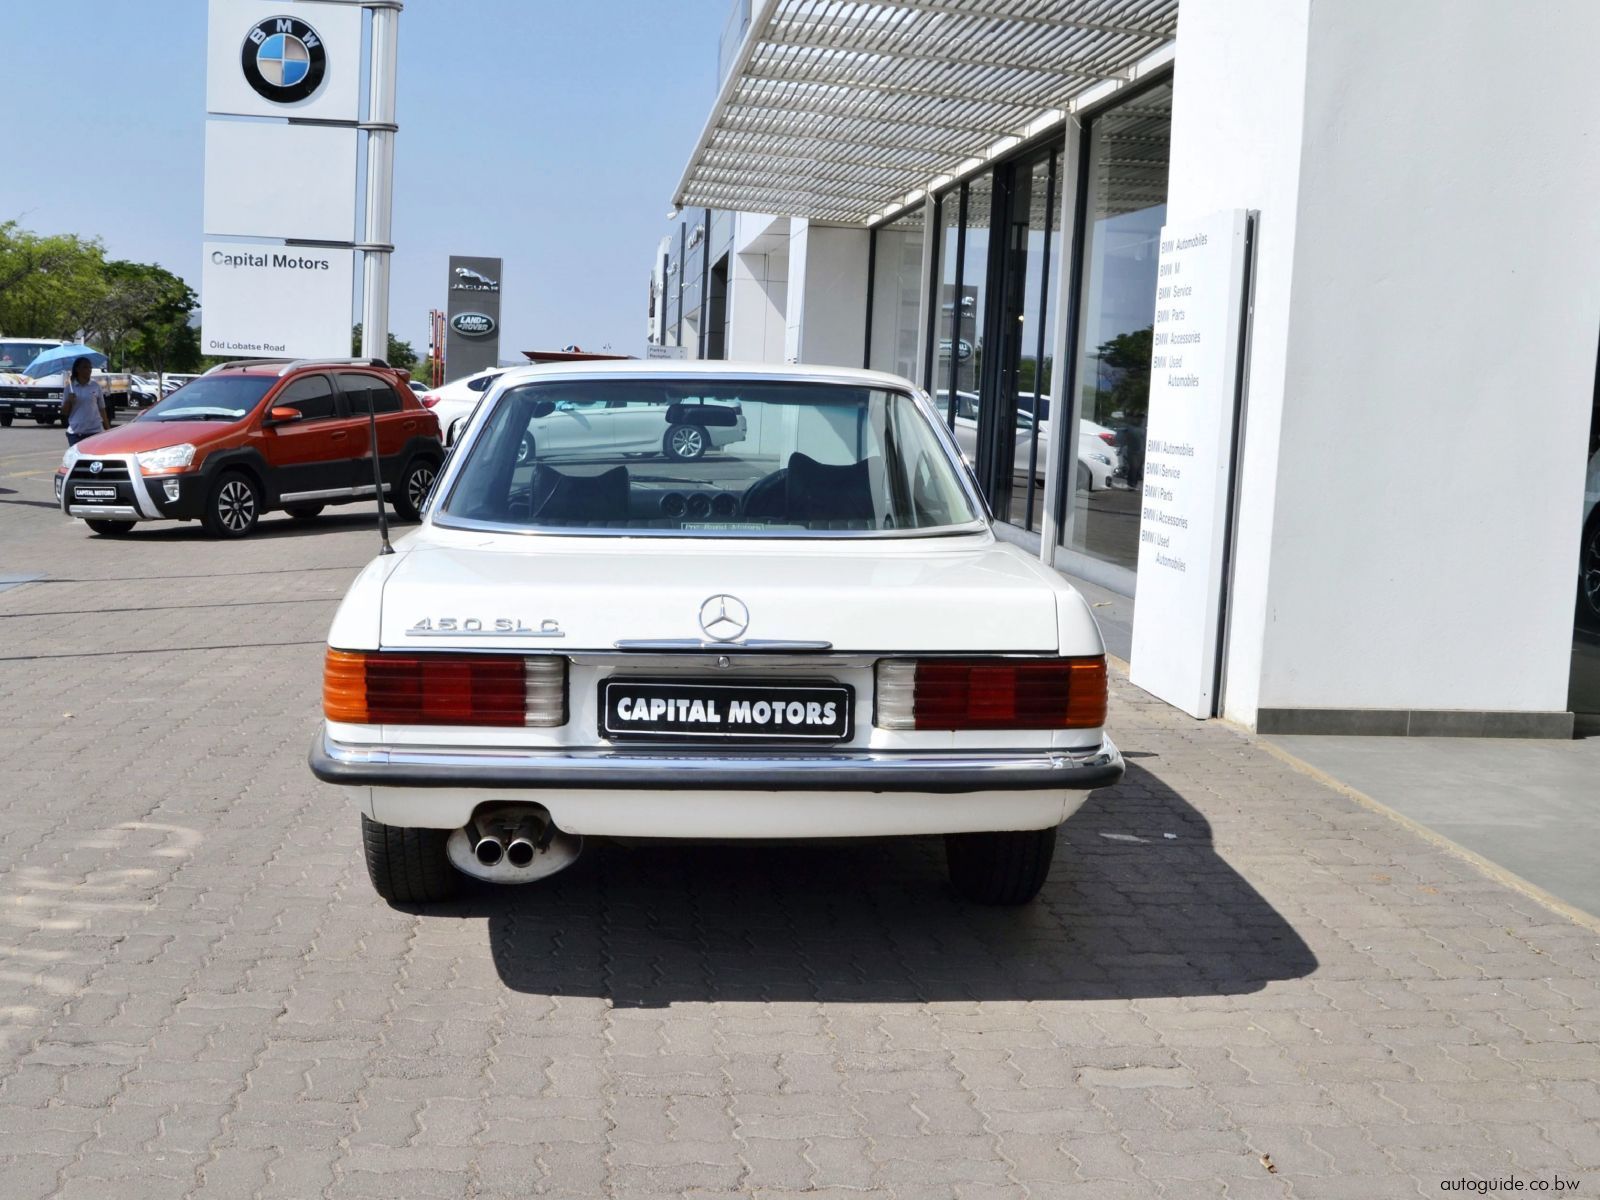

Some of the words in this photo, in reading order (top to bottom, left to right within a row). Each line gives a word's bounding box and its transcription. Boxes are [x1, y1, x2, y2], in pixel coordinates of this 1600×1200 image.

[249, 19, 319, 48] BMW
[1161, 240, 1174, 254] BMW
[1176, 232, 1208, 251] Automobiles
[211, 251, 268, 269] Capital
[273, 254, 329, 270] Motors
[1160, 263, 1172, 277] BMW
[450, 283, 499, 291] JAGUAR
[1158, 286, 1171, 300] BMW
[1173, 284, 1193, 298] Service
[460, 316, 481, 324] LAND
[1157, 309, 1170, 323] BMW
[1171, 308, 1185, 321] Parts
[461, 323, 488, 331] ROVER
[209, 340, 225, 349] Old
[226, 341, 262, 351] Lobatse
[263, 343, 286, 352] Road
[1155, 333, 1168, 346] BMW
[1170, 331, 1201, 345] Accessories
[1153, 355, 1167, 369] BMW
[1168, 355, 1183, 369] Used
[1167, 373, 1200, 387] Automobiles
[1147, 440, 1160, 453] BMW
[1163, 441, 1195, 457] Automobiles
[1146, 462, 1159, 476] BMW
[1162, 463, 1181, 479] Service
[76, 489, 95, 497] CAPITAL
[1144, 484, 1158, 499] BMW
[1160, 487, 1173, 502] Parts
[1143, 507, 1156, 521] BMW
[1159, 510, 1188, 529] Accessories
[1141, 529, 1154, 544] BMW
[1157, 532, 1170, 548] Used
[1156, 551, 1186, 572] Automobiles
[413, 617, 482, 632] 450
[495, 618, 559, 633] SLC
[617, 697, 721, 723] CAPITAL
[727, 700, 837, 726] MOTORS
